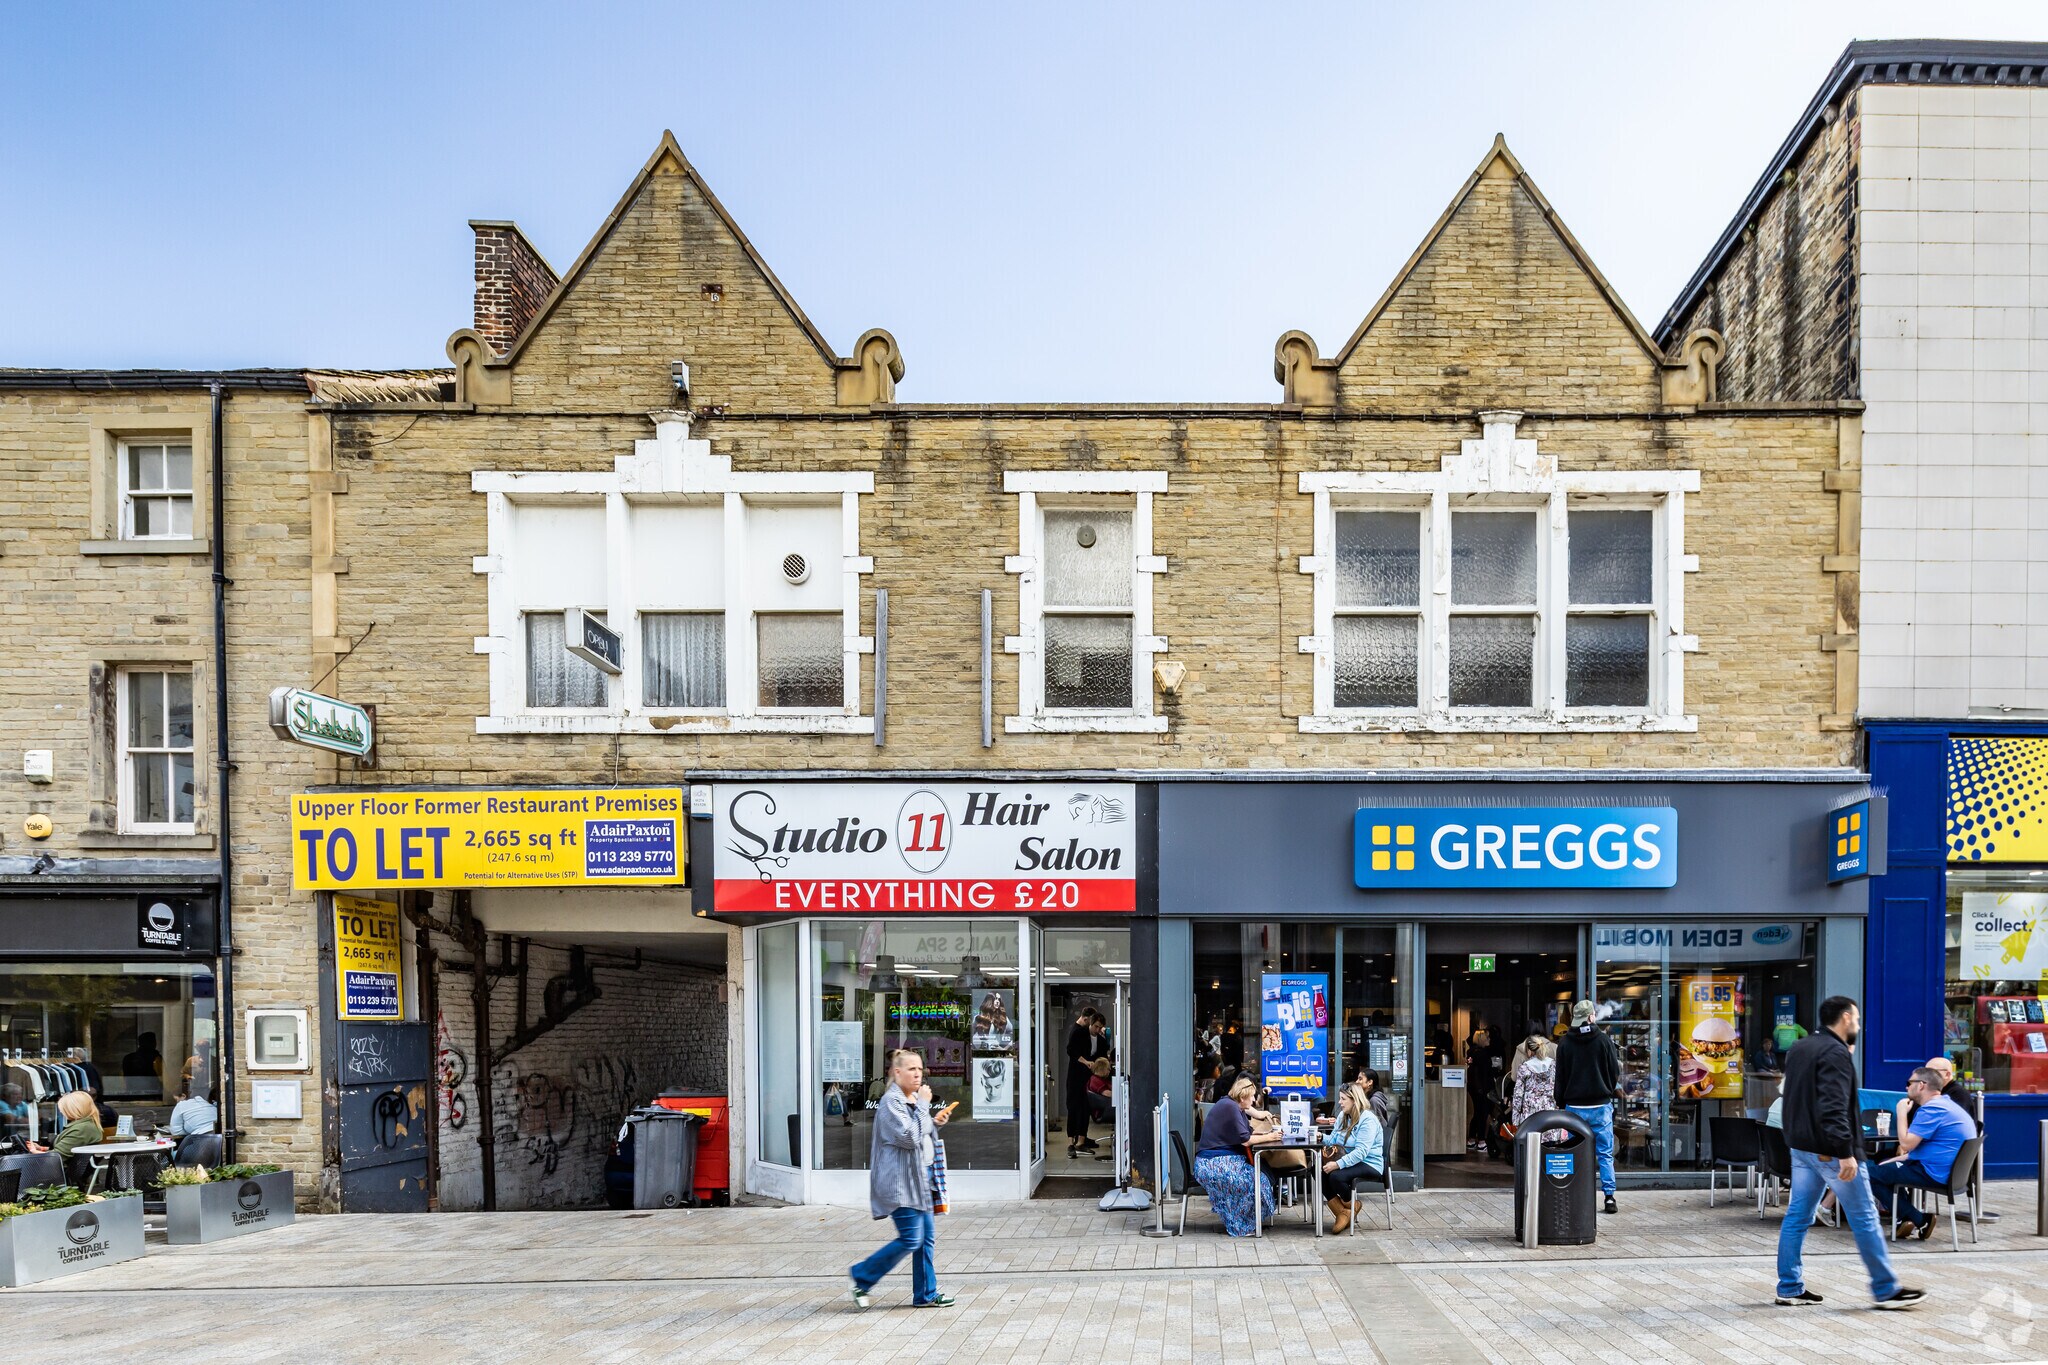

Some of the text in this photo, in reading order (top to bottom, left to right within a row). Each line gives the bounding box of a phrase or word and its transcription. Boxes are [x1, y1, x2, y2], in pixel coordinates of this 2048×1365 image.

[299, 800, 354, 820] Upper
[361, 798, 408, 815] Floor
[415, 798, 481, 814] Former
[487, 796, 589, 814] Restaurant
[595, 794, 678, 812] Premises
[26, 822, 42, 830] Yale
[590, 824, 670, 836] AdairPaxton
[729, 790, 1050, 858] Studio 11 Hair
[464, 829, 577, 850] 2,665 sq ft
[300, 827, 450, 881] TO LET
[1014, 836, 1122, 871] Salon
[1430, 824, 1661, 870] GREGGS
[487, 852, 554, 864] (247.6 sq m)
[588, 851, 673, 862] 0113 239 5770
[588, 866, 673, 874] www.adairpaxton.co.uk
[1836, 858, 1860, 872] GREGGS
[507, 871, 544, 879] Alternative
[562, 870, 578, 879] (STP)
[776, 882, 1079, 908] EVERYTHING £20
[354, 899, 380, 908] Upper Floor
[339, 915, 396, 940] TO LET
[1975, 918, 2032, 932] collect.
[141, 930, 181, 941] TURNTABLE
[344, 947, 396, 962] 2,665 sq ft
[349, 975, 395, 985] AdairPaxton
[348, 996, 397, 1005] 0113 239 5770
[1694, 986, 1731, 1002] £5.95
[1296, 1020, 1313, 1029] DEAL
[1296, 1031, 1314, 1051] £5
[232, 1208, 269, 1222] TURNTABLE
[58, 1240, 110, 1259] TURNTABLE
[63, 1255, 83, 1264] COFFEE
[90, 1250, 105, 1258] VINYL
